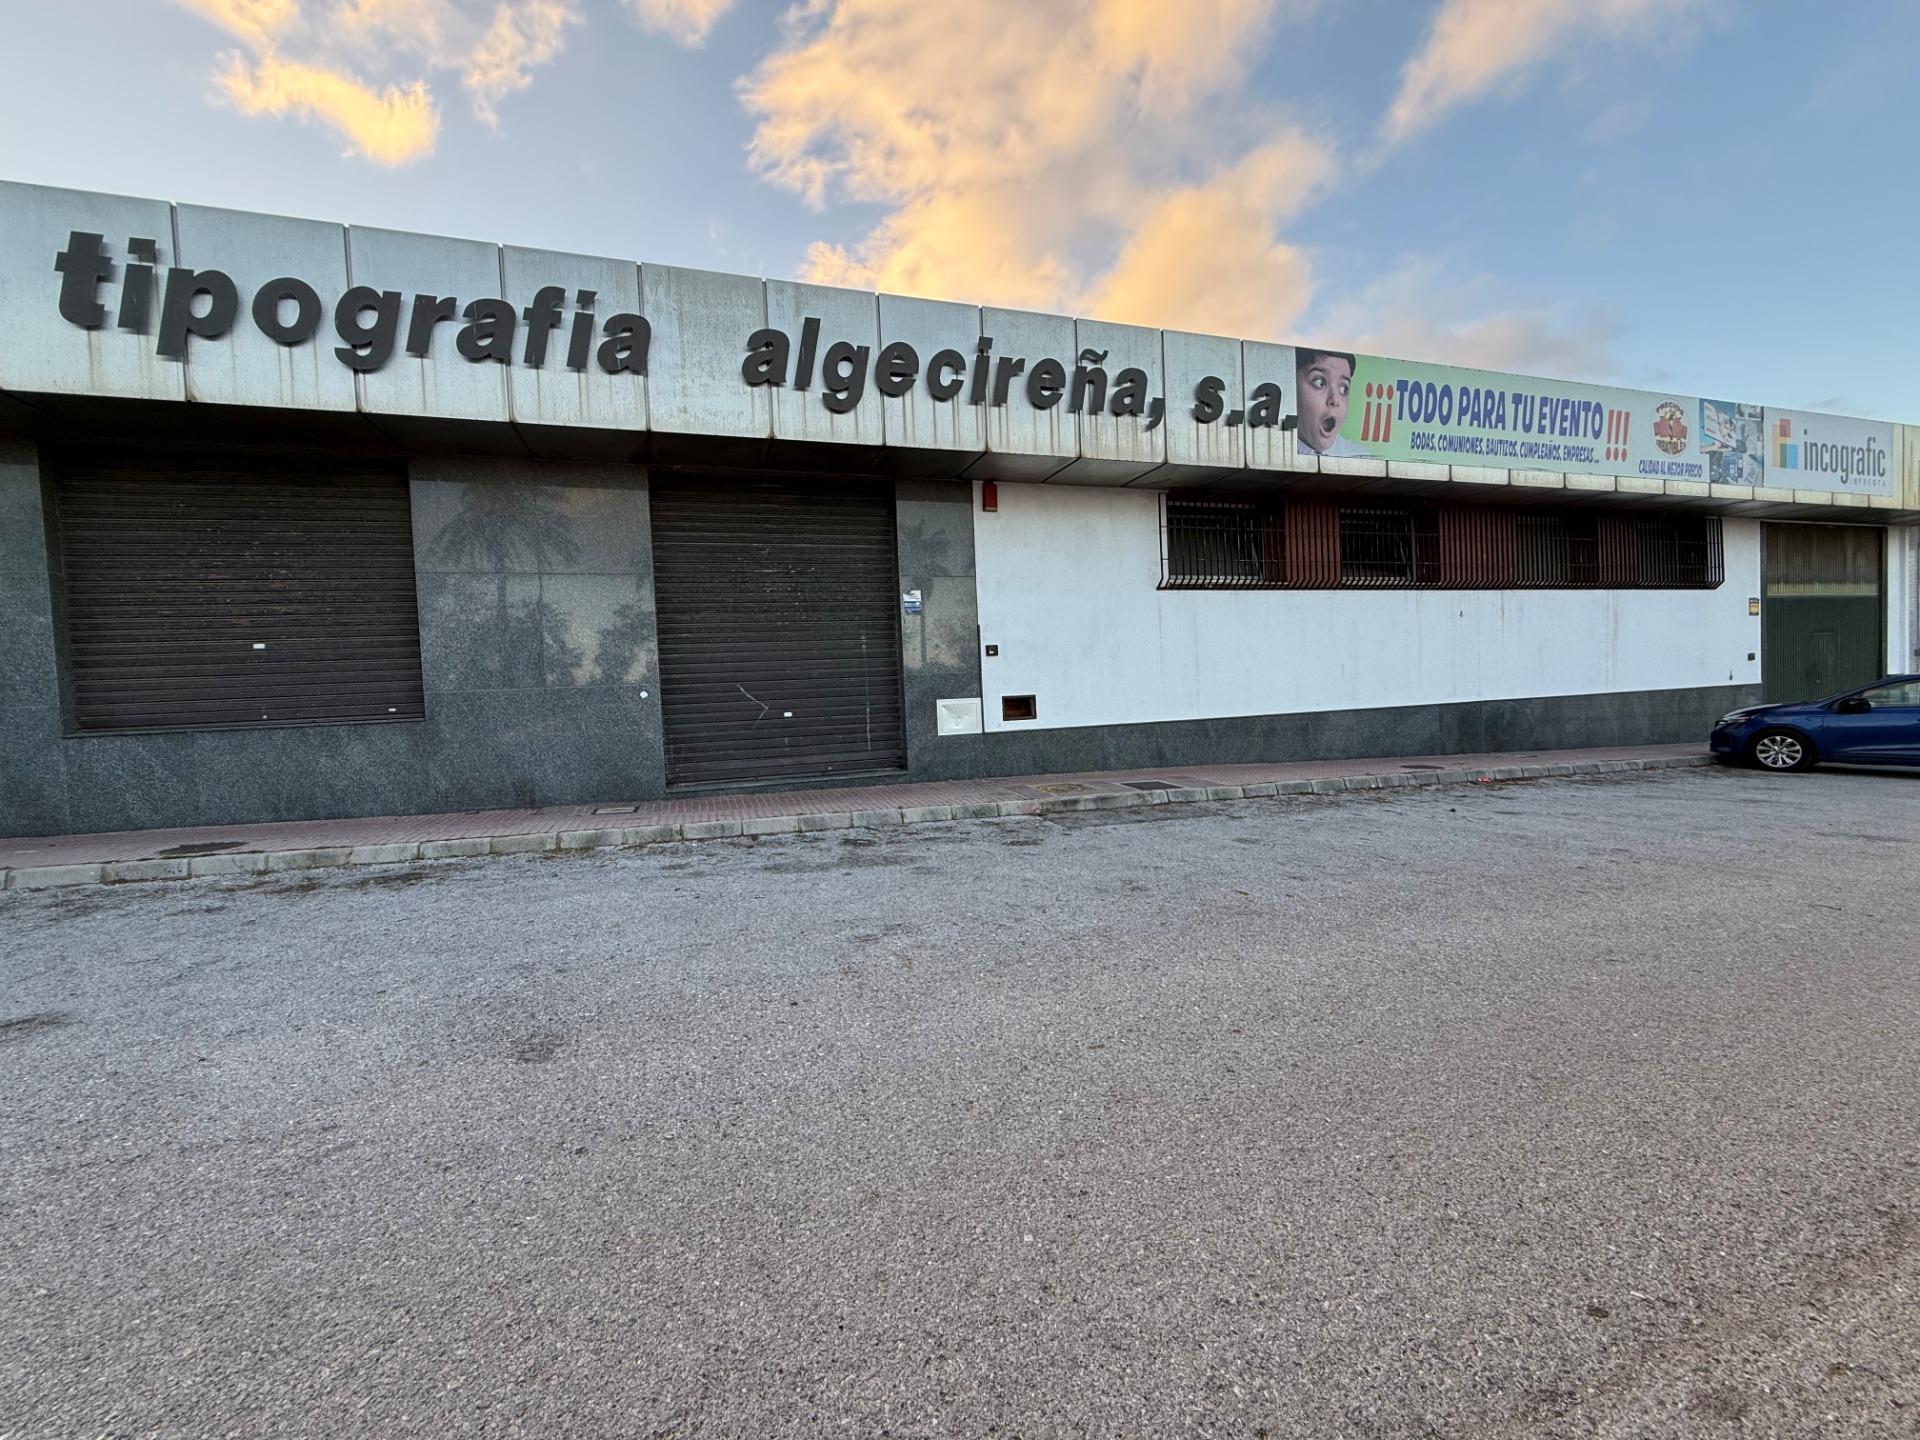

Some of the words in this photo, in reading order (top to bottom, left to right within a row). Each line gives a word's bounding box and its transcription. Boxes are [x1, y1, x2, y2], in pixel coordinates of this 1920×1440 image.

[741, 317, 1164, 432] algecireña,
[1194, 375, 1298, 429] s.a.
[1457, 386, 1506, 431] PARA
[1512, 393, 1535, 434] TU
[1803, 428, 1886, 484] incografic
